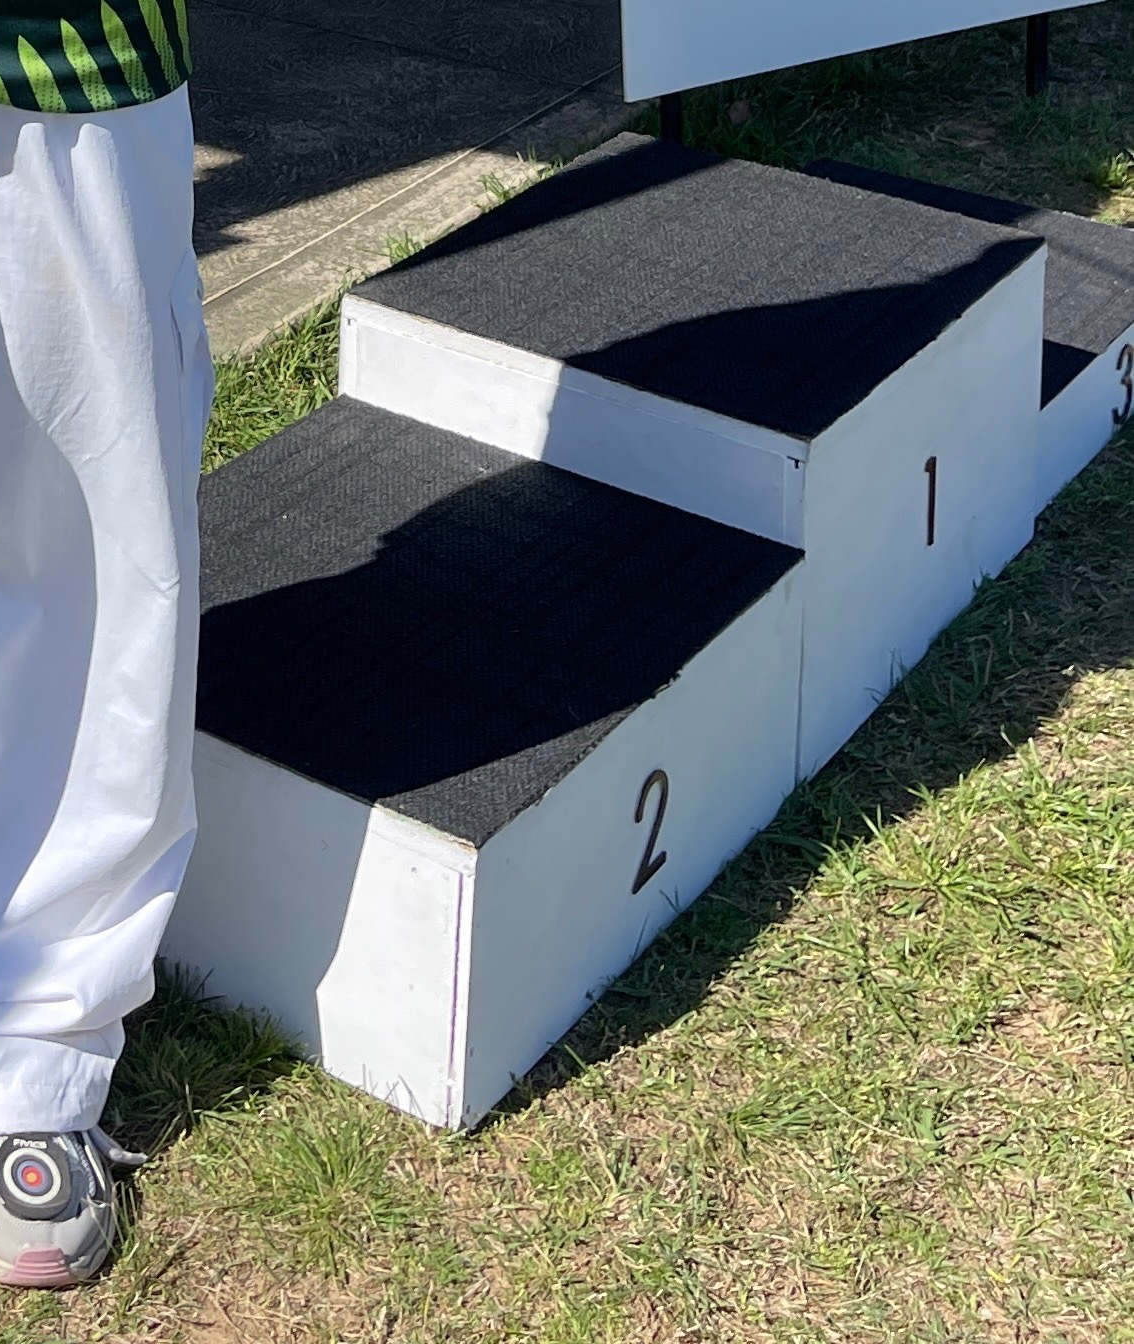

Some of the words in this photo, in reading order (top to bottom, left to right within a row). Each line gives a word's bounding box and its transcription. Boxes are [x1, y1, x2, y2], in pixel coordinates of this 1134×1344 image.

[1111, 343, 1134, 425] 3
[922, 455, 937, 547] 1
[632, 769, 668, 895] 2
